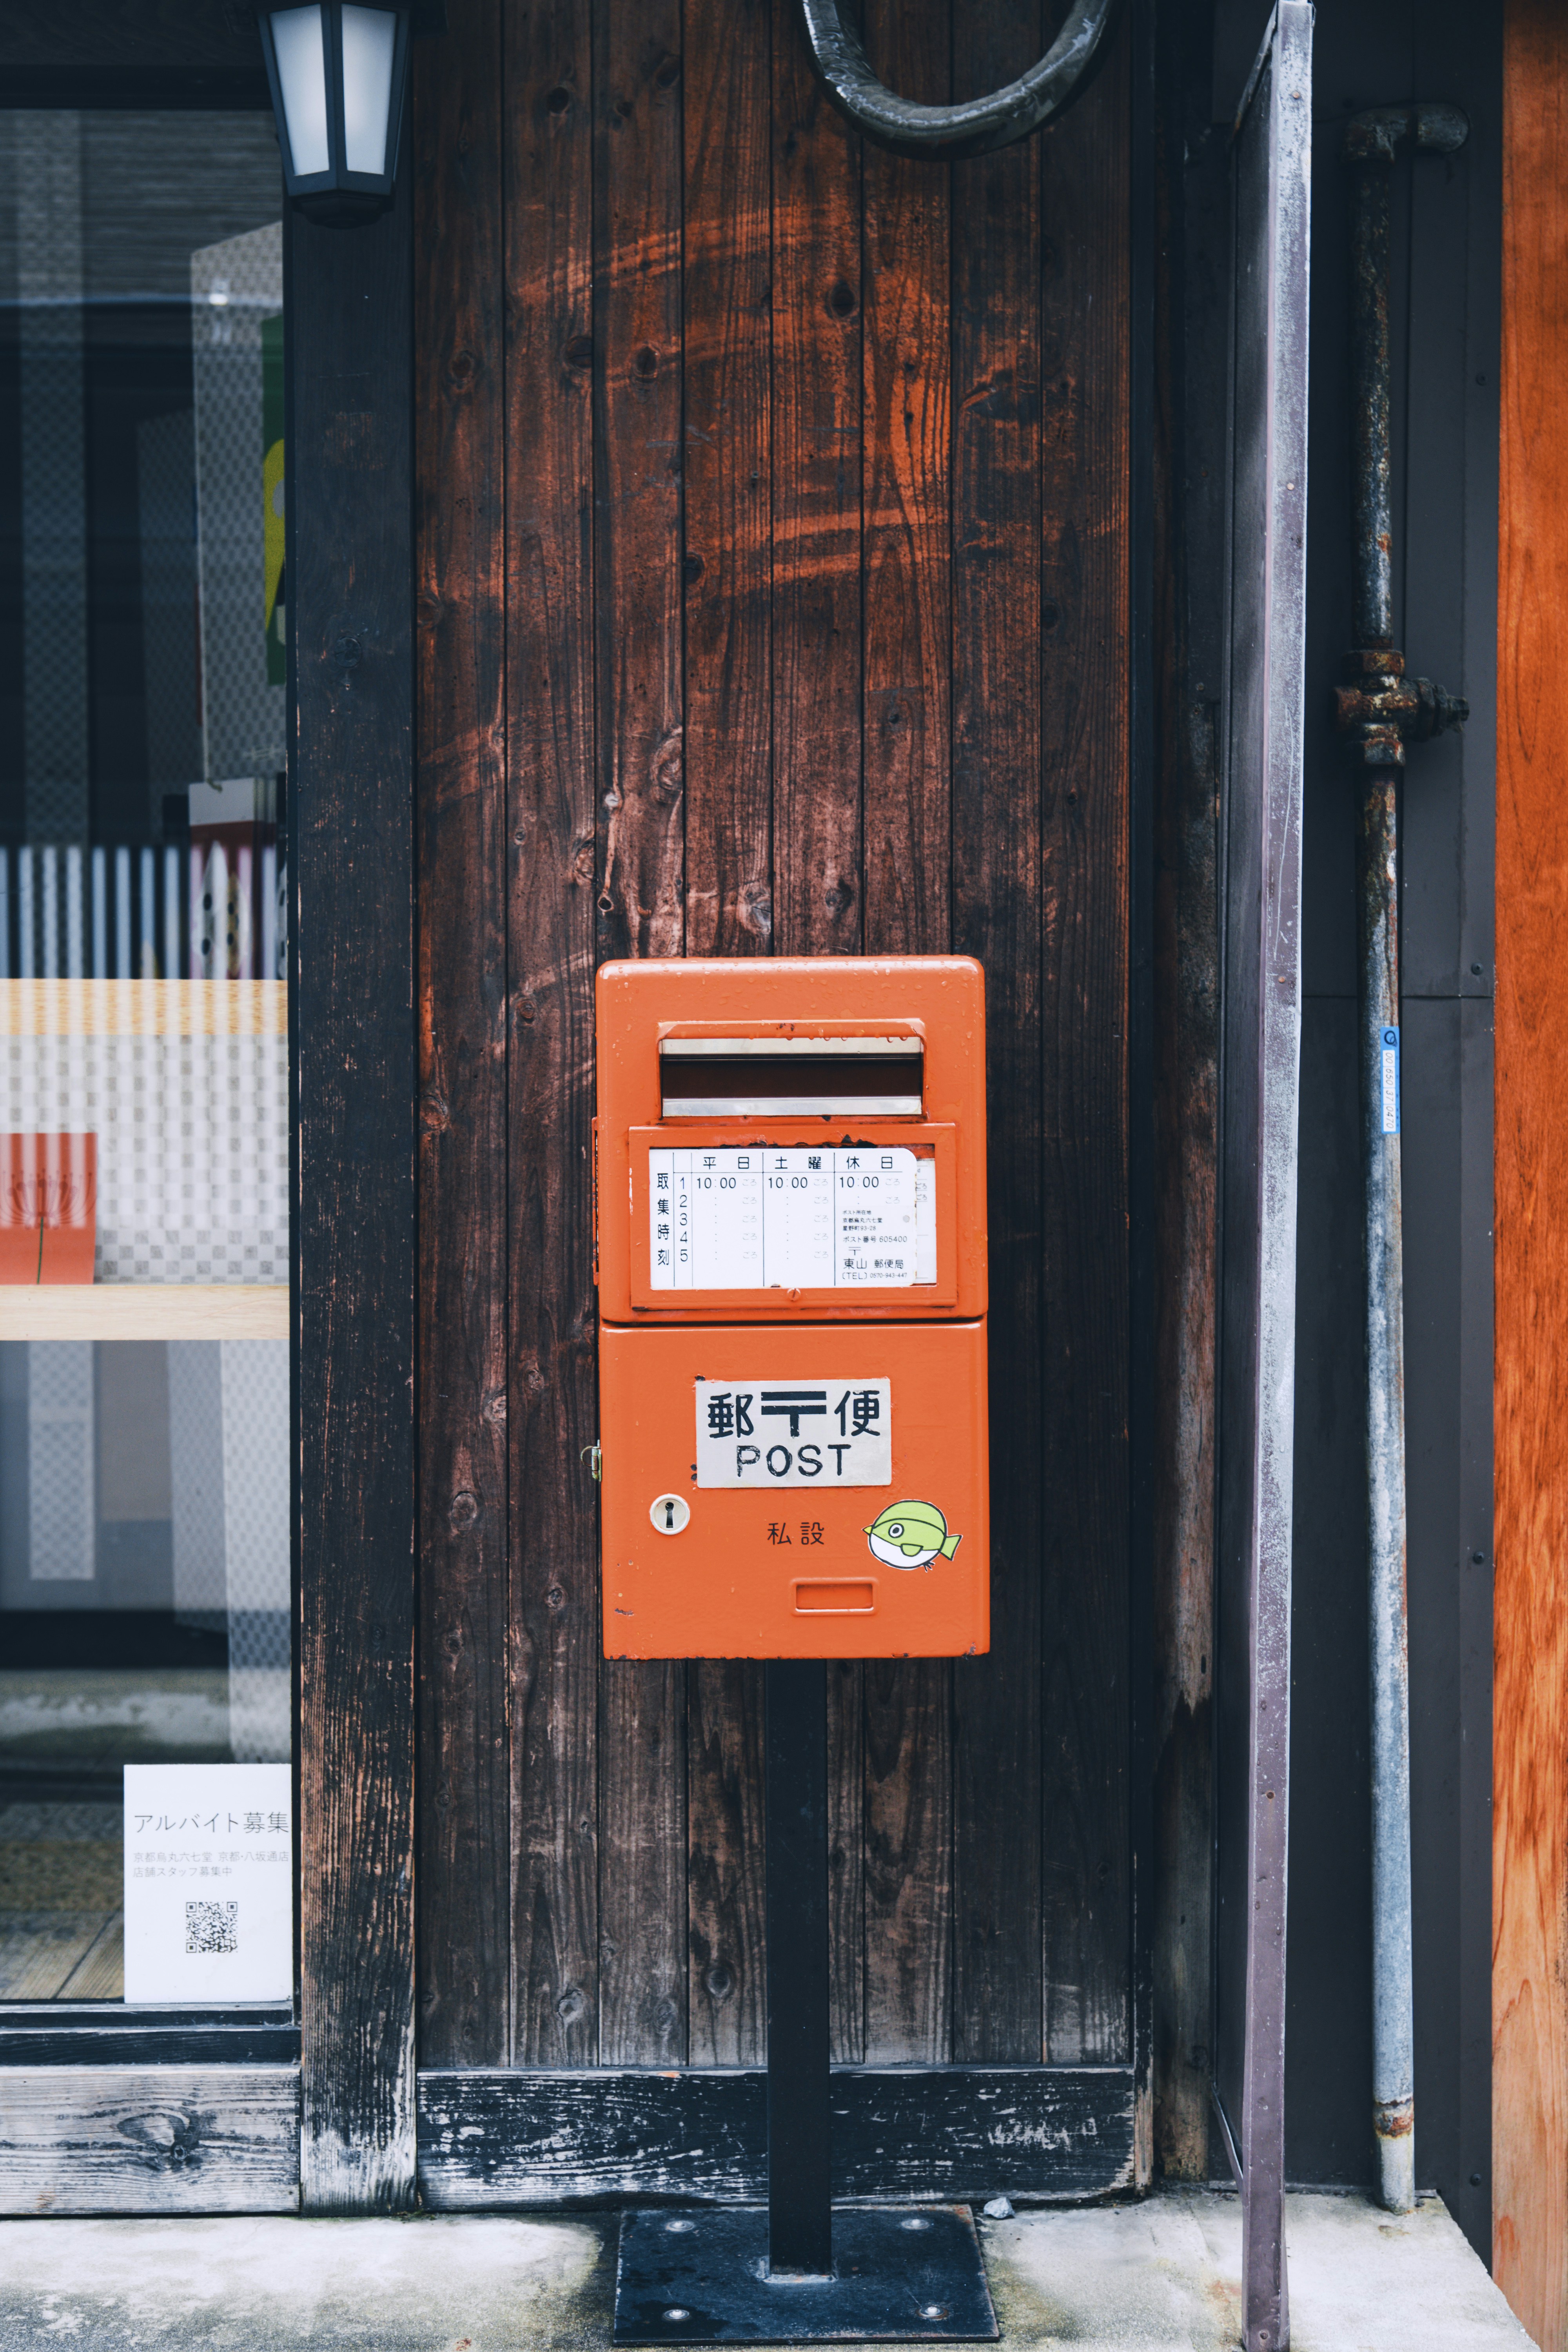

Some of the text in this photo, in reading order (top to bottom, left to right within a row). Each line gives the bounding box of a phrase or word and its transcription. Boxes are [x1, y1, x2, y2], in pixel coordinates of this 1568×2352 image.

[1385, 1053, 1393, 1064] 00
[1386, 1090, 1394, 1102] 37
[680, 1177, 684, 1189] 1
[697, 1177, 736, 1189] 10:00
[768, 1177, 808, 1189] 10:00
[840, 1176, 879, 1188] 10:00
[679, 1194, 687, 1207] 2
[657, 1173, 670, 1265] 取集時刻
[680, 1213, 687, 1226] 3
[680, 1231, 688, 1243] 4
[681, 1249, 688, 1262] 5
[844, 1258, 904, 1269] 東山 郵便局
[736, 1444, 852, 1477] POST
[767, 1522, 824, 1545] 私設
[134, 1811, 289, 1833] アルバイト募集
[133, 1866, 232, 1877] 店舗スタッフ募集中
